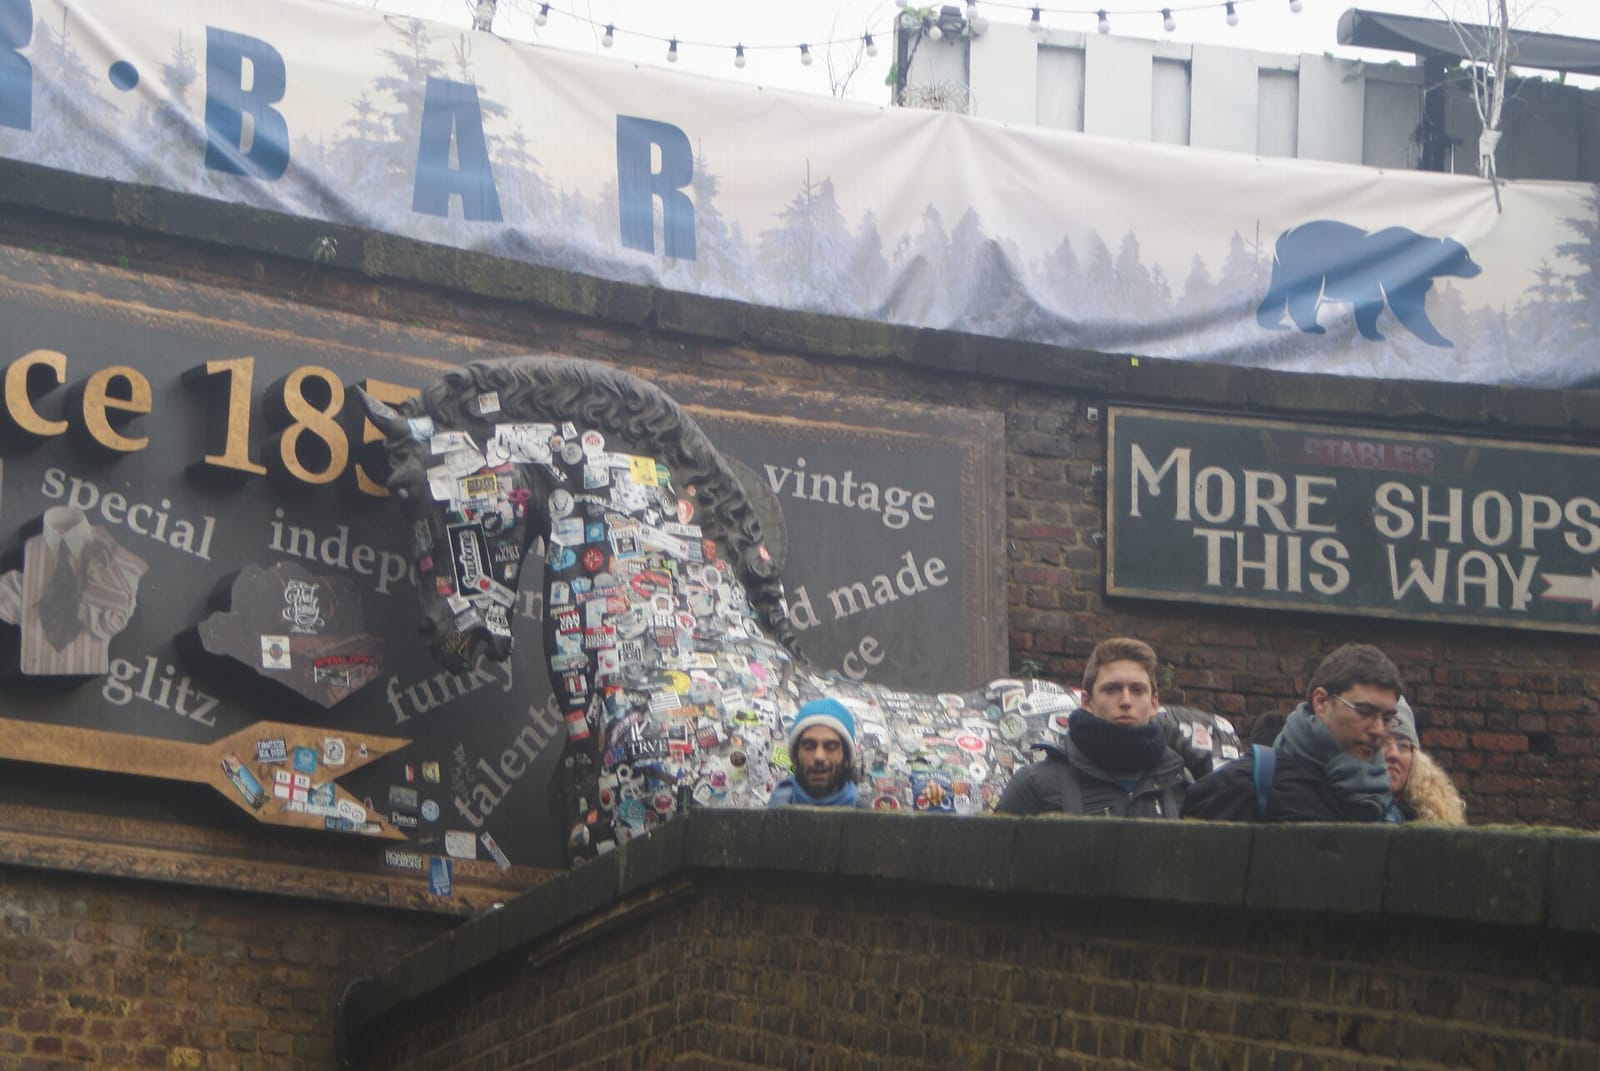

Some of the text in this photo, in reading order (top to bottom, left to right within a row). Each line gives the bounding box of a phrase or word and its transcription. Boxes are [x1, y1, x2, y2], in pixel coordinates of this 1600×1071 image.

[5, 349, 153, 452] ce
[763, 457, 936, 529] vintage
[1303, 438, 1435, 473] STABLES
[41, 467, 216, 561] special
[1129, 443, 1600, 555] MORE SHOPS
[268, 507, 417, 595] indep
[826, 550, 949, 620] made
[1194, 527, 1541, 612] THIS WAY
[102, 656, 220, 728] glitz
